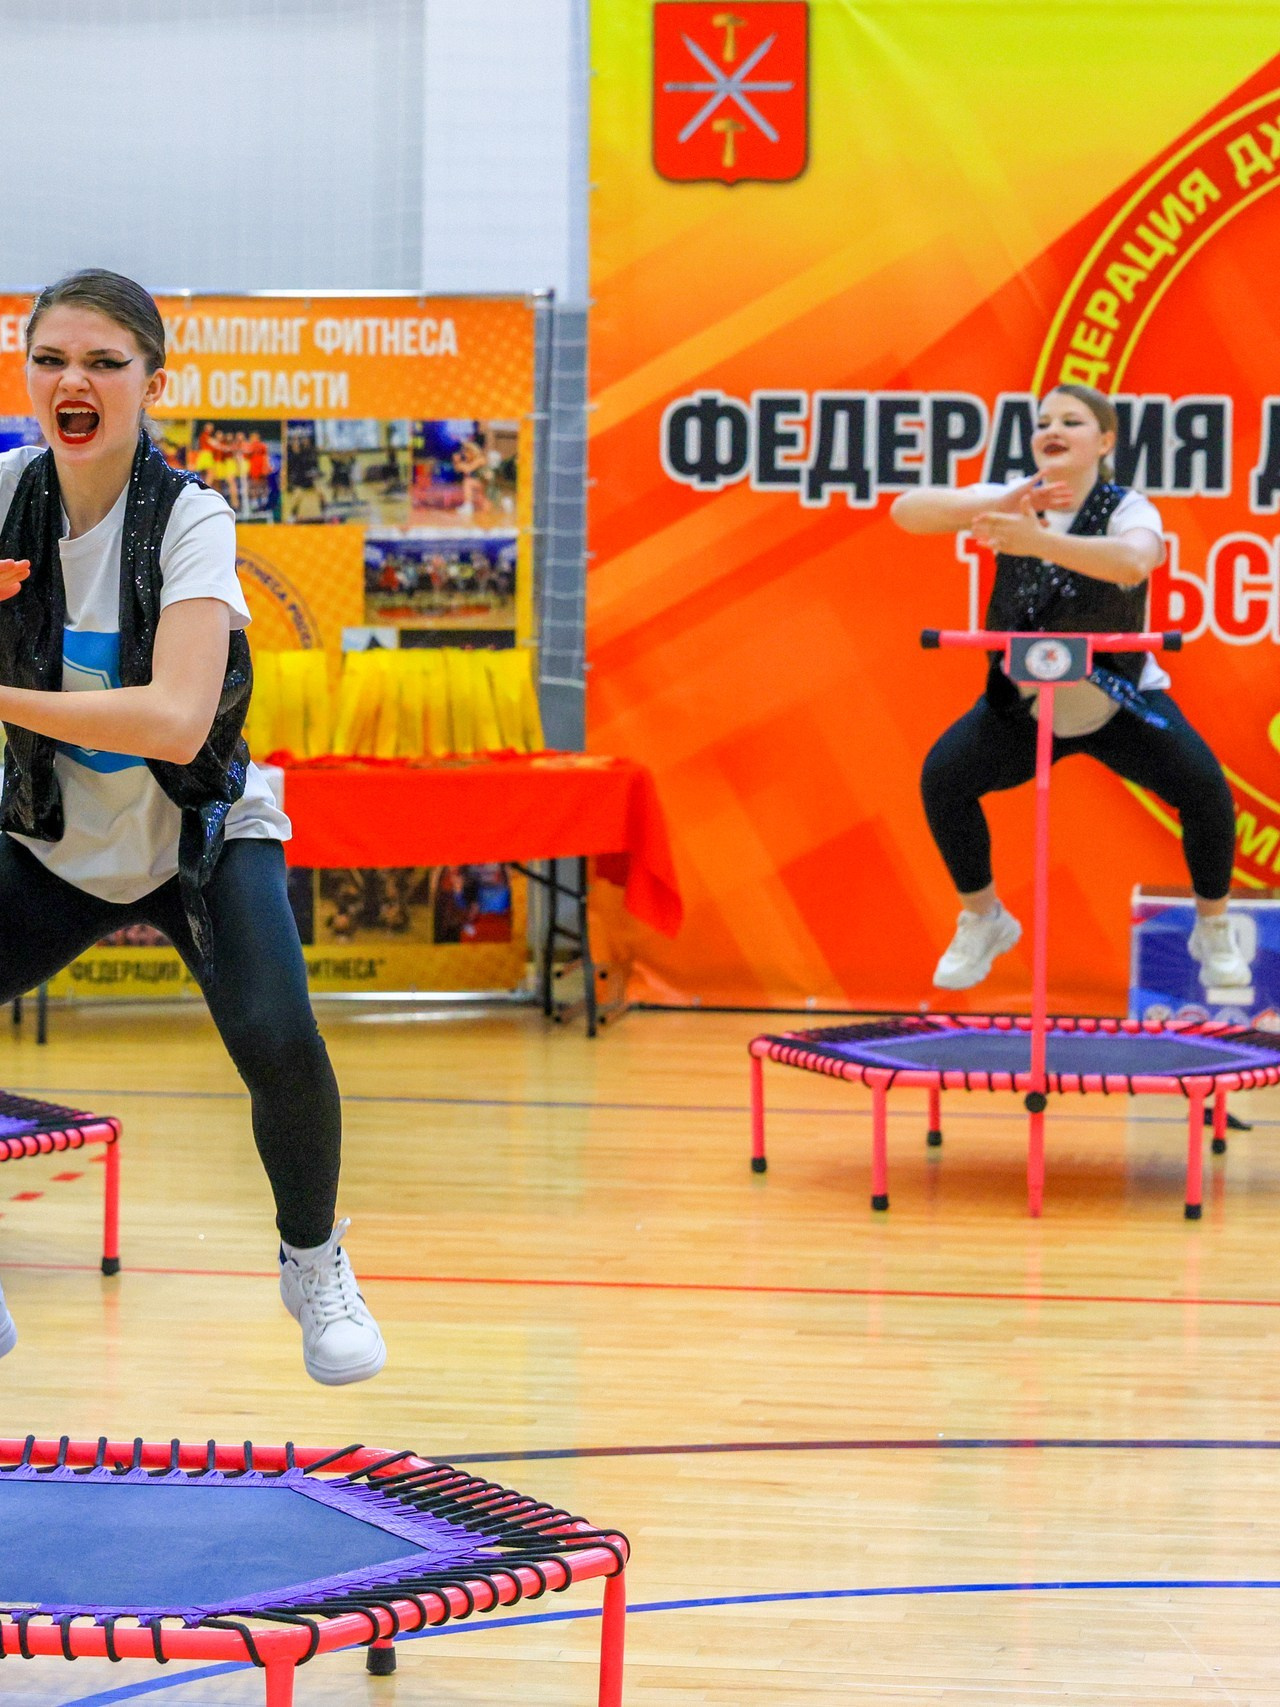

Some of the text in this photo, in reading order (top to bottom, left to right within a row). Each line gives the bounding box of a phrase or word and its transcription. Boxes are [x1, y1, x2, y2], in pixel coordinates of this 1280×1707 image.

[314, 316, 458, 356] ФИТНЕСА
[209, 370, 349, 409] ОБЛАСТИ
[660, 389, 1233, 509] ФЕДЕРАИЯ
